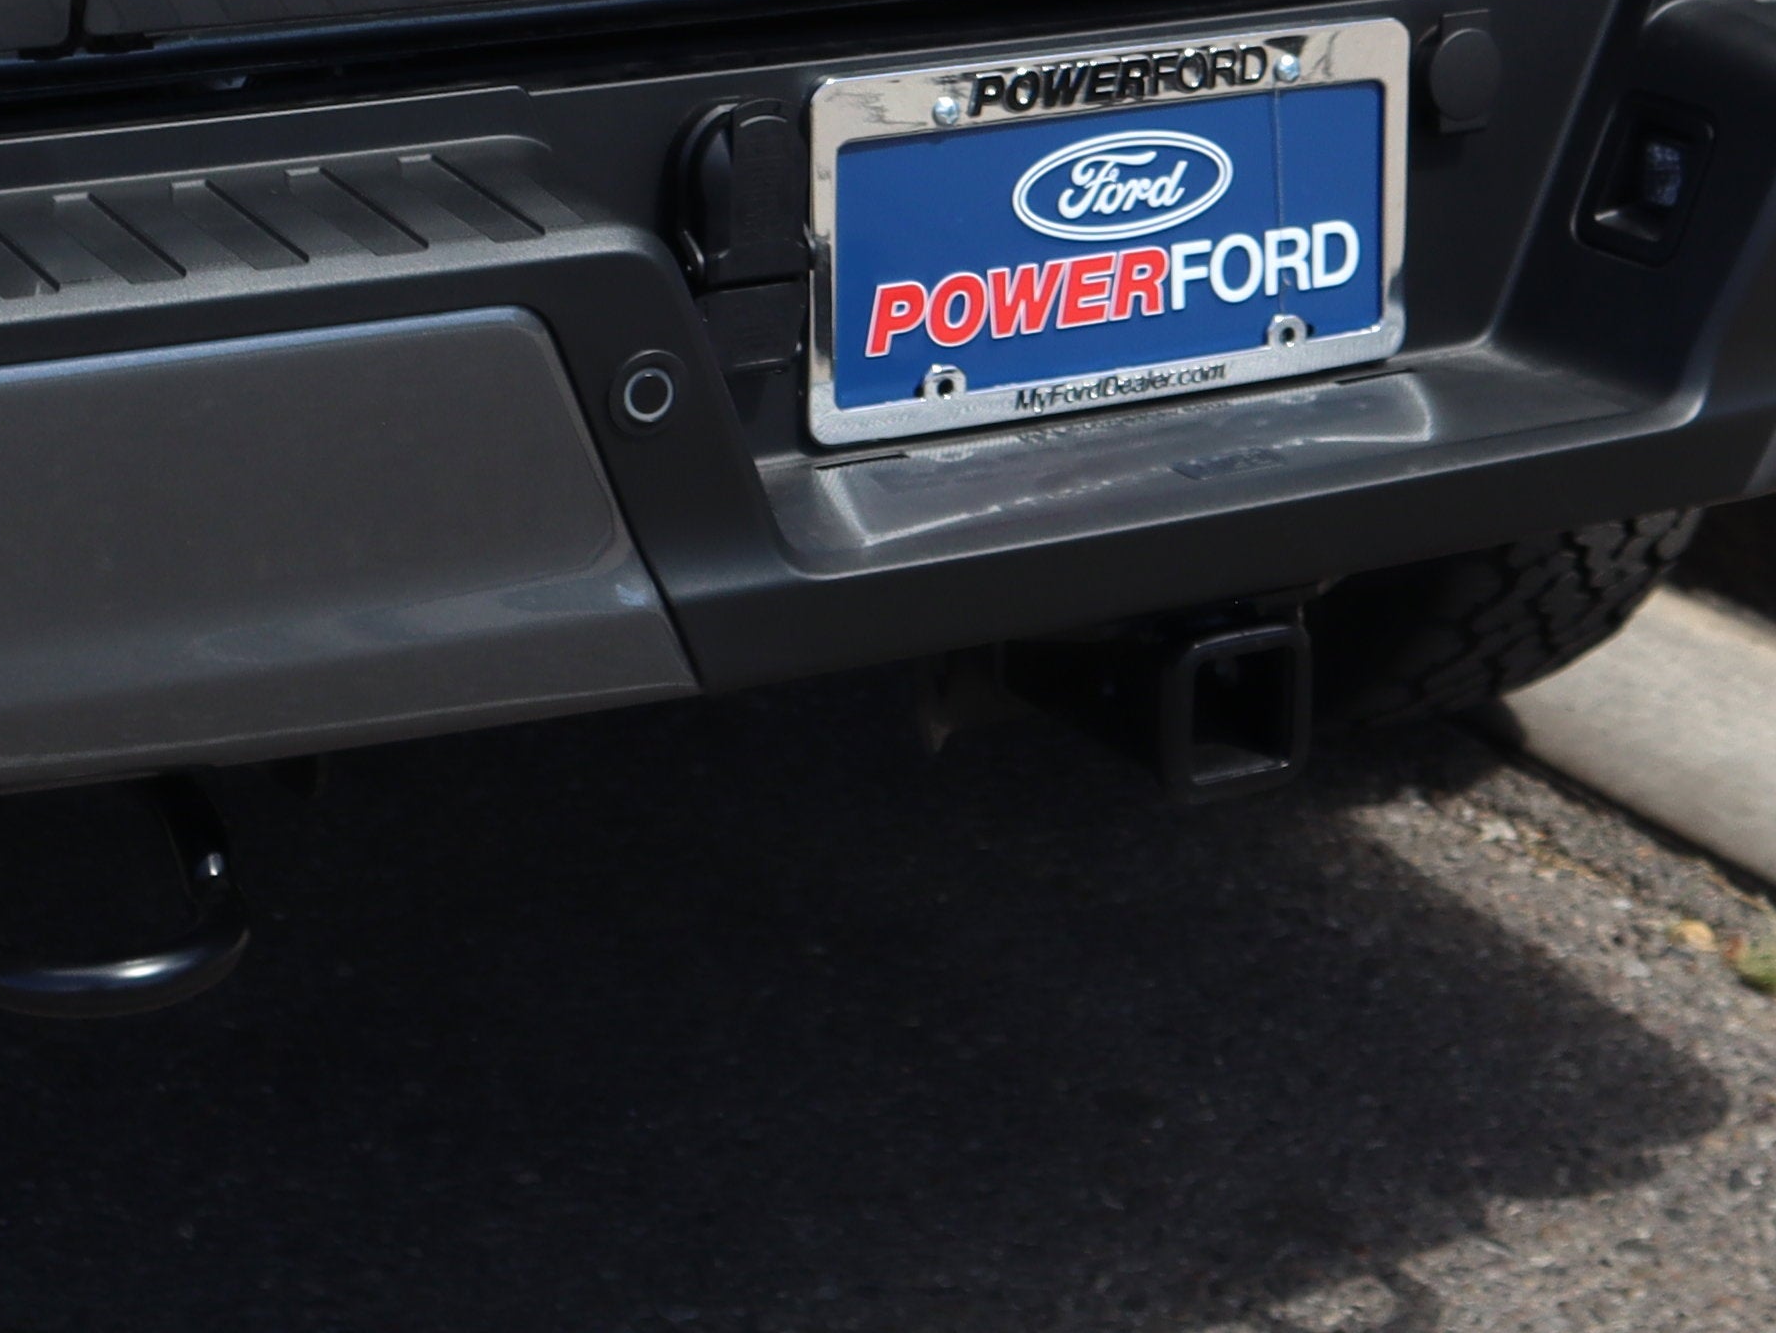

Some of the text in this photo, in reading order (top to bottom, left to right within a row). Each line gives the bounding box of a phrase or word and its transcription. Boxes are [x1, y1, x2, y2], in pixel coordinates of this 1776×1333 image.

[967, 44, 1268, 118] POWERFORD
[1058, 150, 1189, 220] Ford
[865, 220, 1360, 358] POWERFORD
[1014, 364, 1225, 412] MyFordDealer.com
